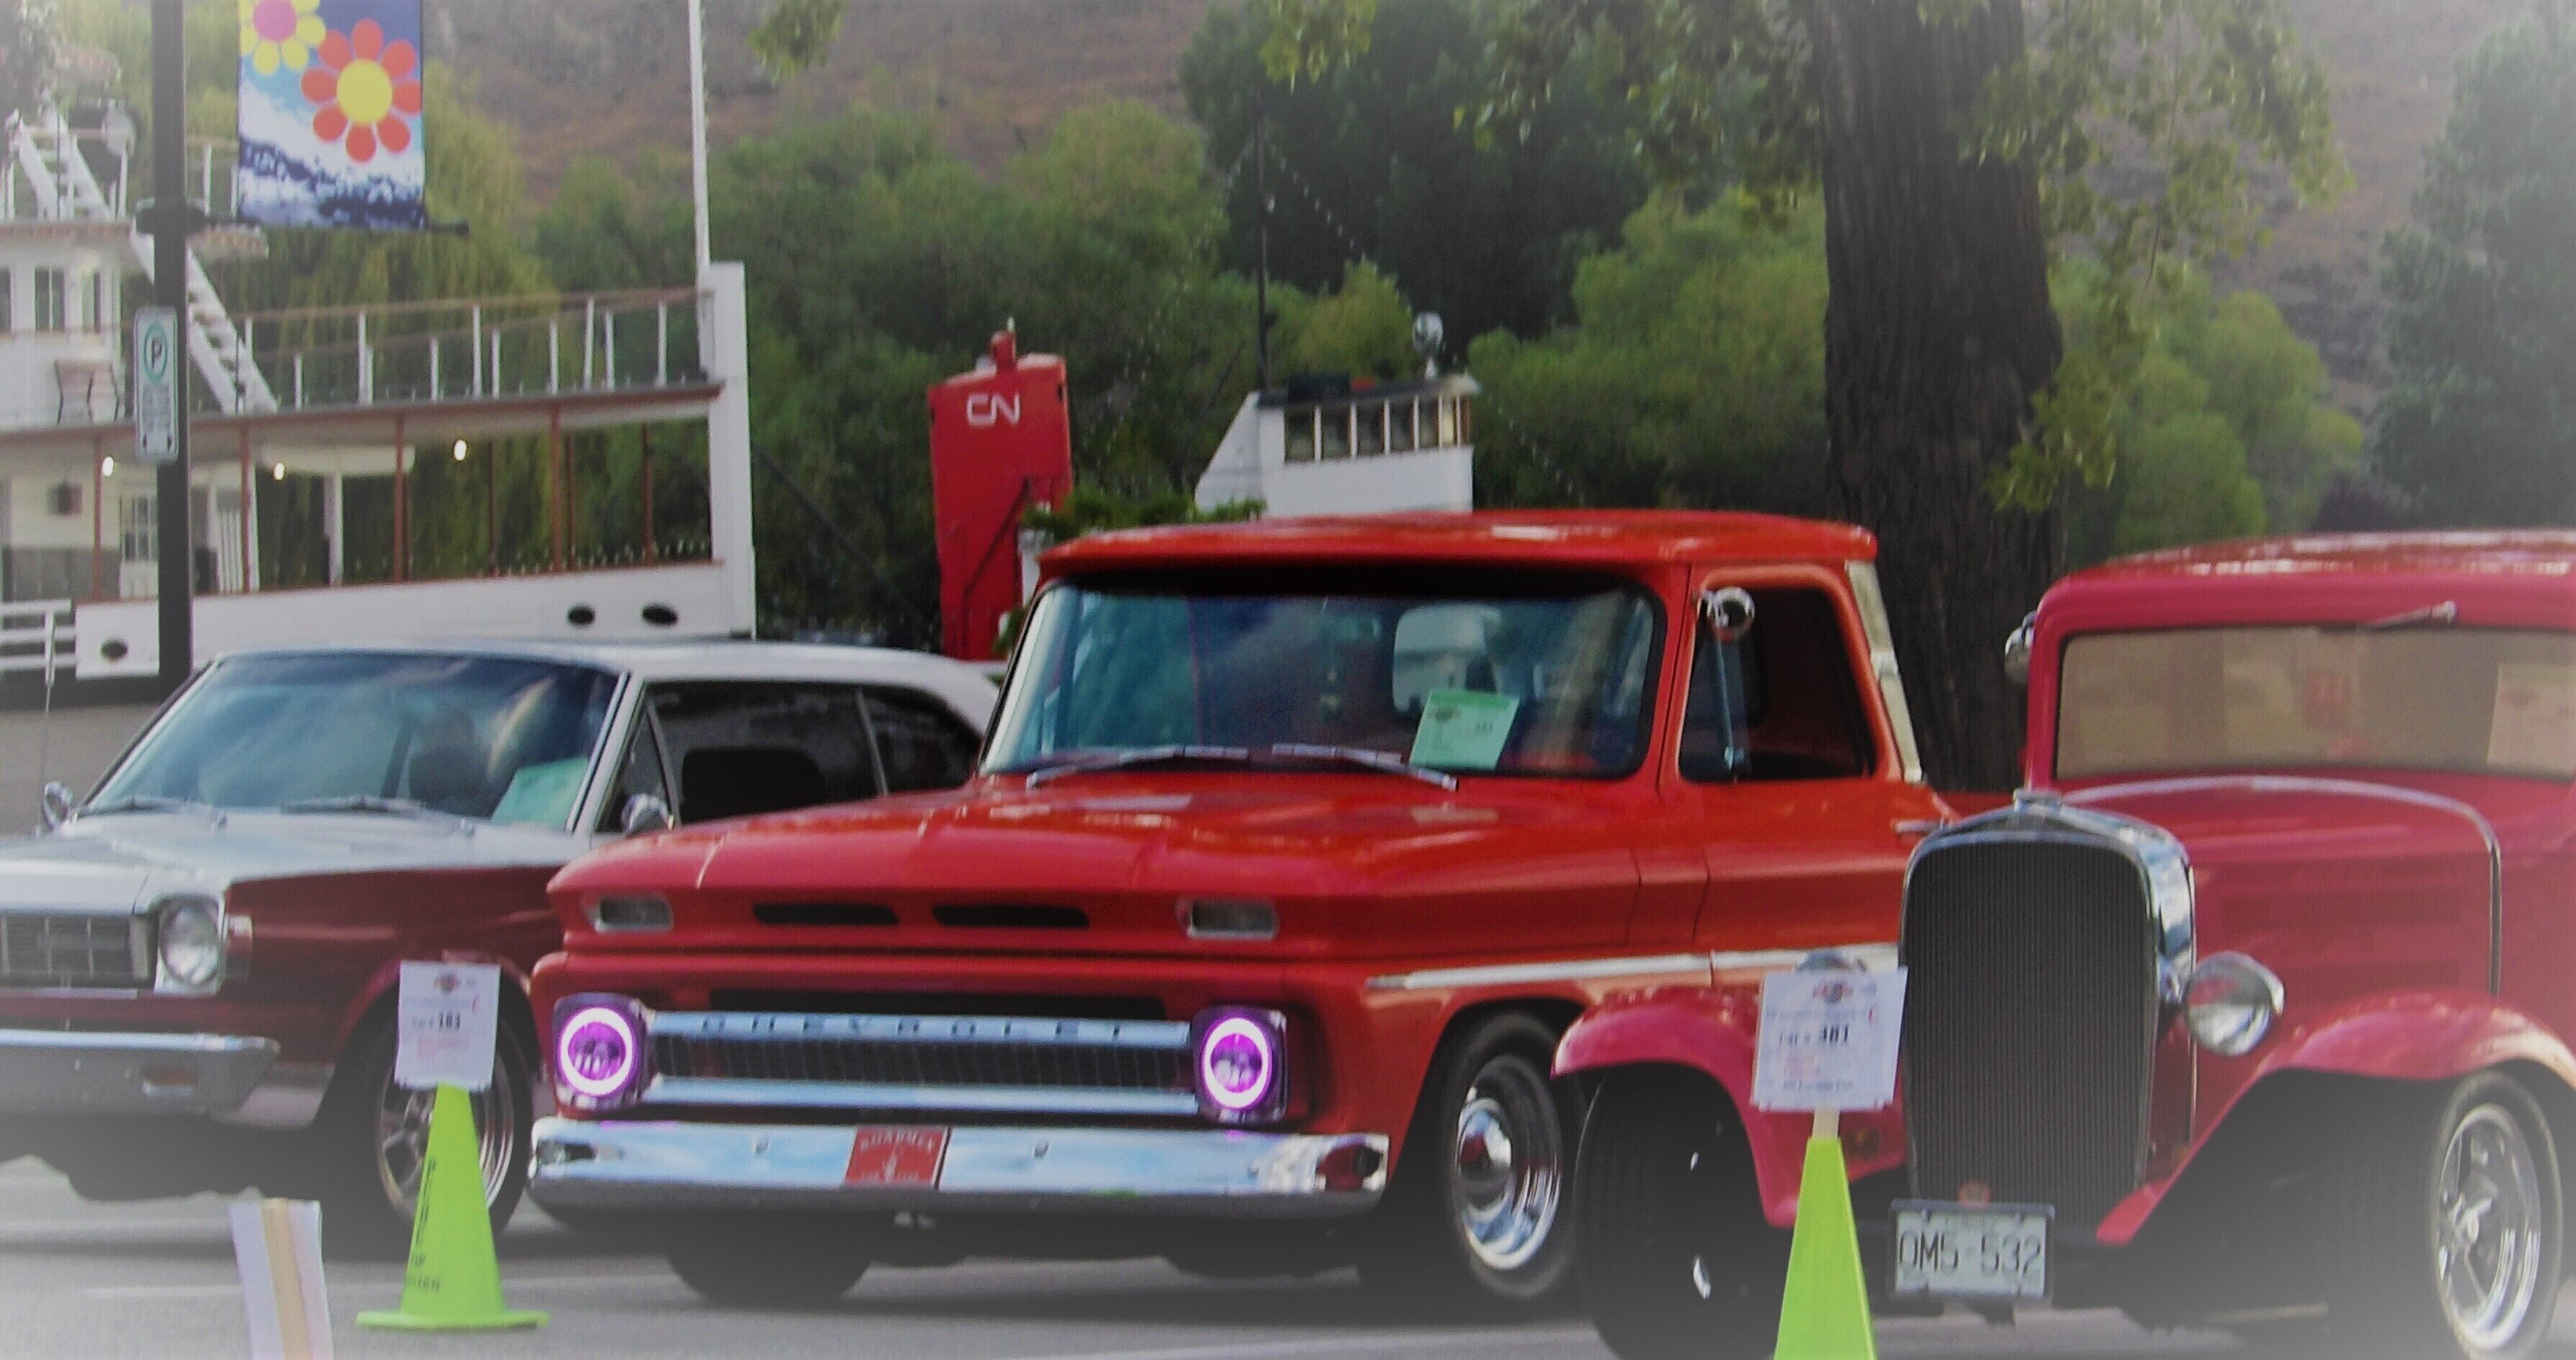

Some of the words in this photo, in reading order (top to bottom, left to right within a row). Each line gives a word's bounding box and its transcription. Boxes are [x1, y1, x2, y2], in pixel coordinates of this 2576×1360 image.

[151, 337, 163, 369] P
[967, 393, 1020, 426] CN
[700, 1015, 1126, 1040] CHEVROLET
